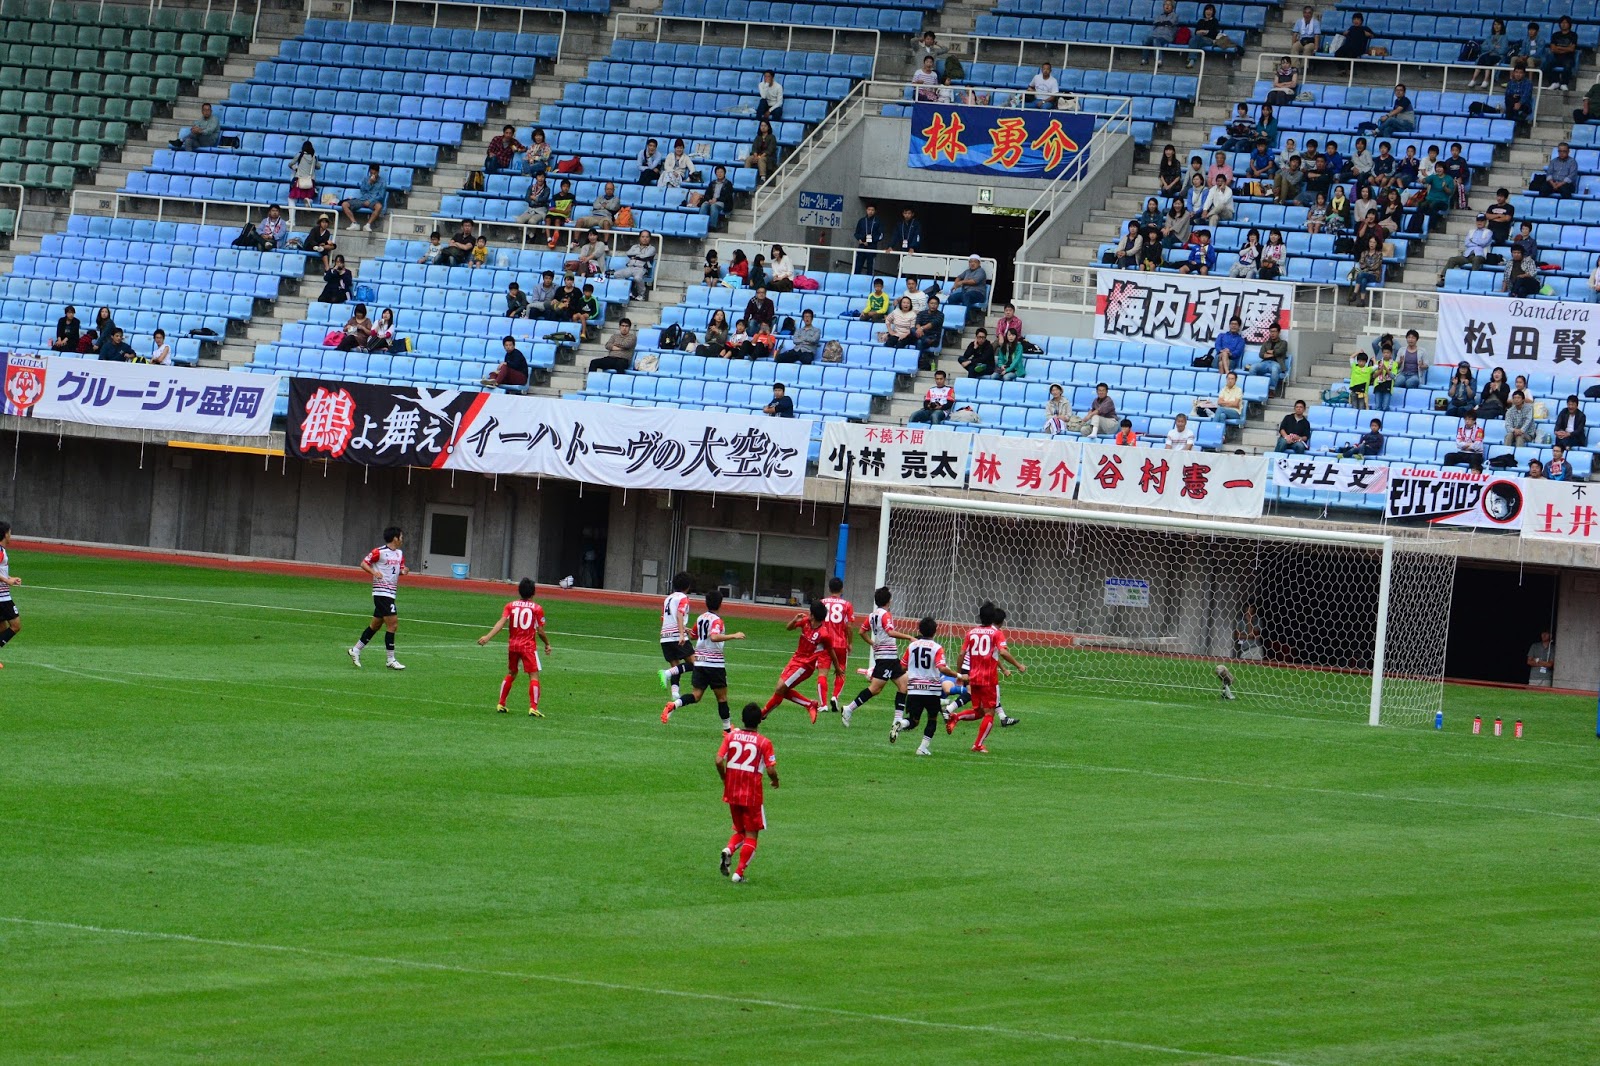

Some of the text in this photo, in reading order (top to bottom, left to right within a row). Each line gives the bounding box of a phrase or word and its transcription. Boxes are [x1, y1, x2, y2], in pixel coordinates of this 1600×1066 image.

[922, 112, 1077, 171] 林 勇介
[101, 200, 110, 209] 09
[415, 225, 424, 233] 09
[1072, 275, 1082, 283] 09
[1508, 300, 1590, 322] Bandiera
[1464, 318, 1600, 366] 松田賢
[56, 369, 266, 420] グルージャ盛岡
[828, 443, 959, 480] 小林 亮太
[973, 451, 1076, 494] 林 勇介
[1288, 462, 1340, 486] 井上
[511, 606, 533, 630] 10
[825, 603, 844, 624] 18
[812, 631, 819, 640] 9
[969, 633, 991, 656] 20
[911, 646, 932, 670] 15
[726, 741, 758, 773] 22
